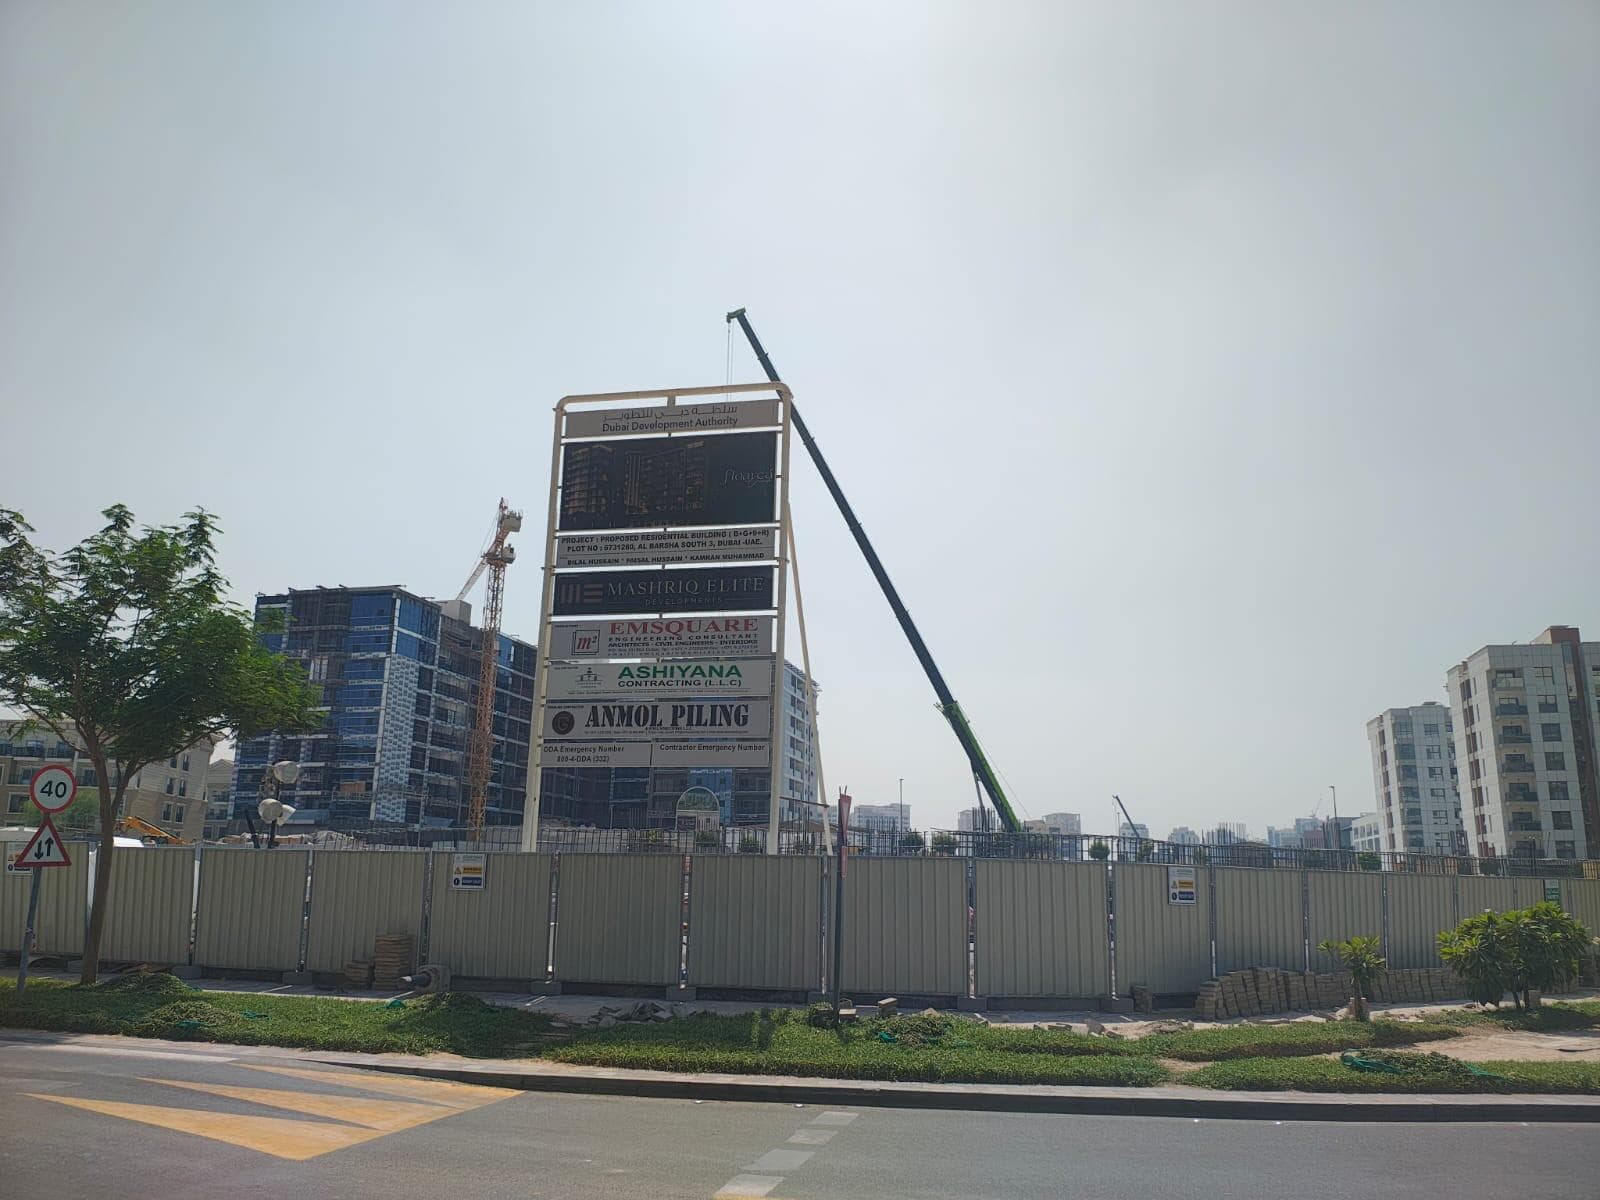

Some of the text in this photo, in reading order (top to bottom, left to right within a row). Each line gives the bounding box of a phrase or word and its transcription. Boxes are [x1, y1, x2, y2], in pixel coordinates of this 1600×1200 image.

[602, 415, 738, 432] Dubai Development Authority
[561, 536, 594, 544] PROJECT
[600, 535, 639, 543] PROPOSED
[641, 533, 689, 541] RESIDENTIAL
[691, 531, 727, 539] BUILDING
[649, 541, 679, 549] BARSHA
[717, 539, 741, 547] DUBAI
[722, 552, 765, 560] MUHAMMAD
[608, 577, 764, 597] MASHRIQ ELITE
[609, 618, 759, 636] EMSQUARE
[608, 633, 759, 643] ENGINEERING CONSULTANT
[618, 664, 742, 679] ASHIYANA
[618, 679, 742, 688] CONTRACTING (L.L.C)
[585, 703, 749, 728] ANMOL PILING
[559, 745, 596, 754] Emergency
[598, 744, 625, 752] Number
[659, 742, 766, 753] Contractor Emergency Number
[40, 780, 67, 798] 40
